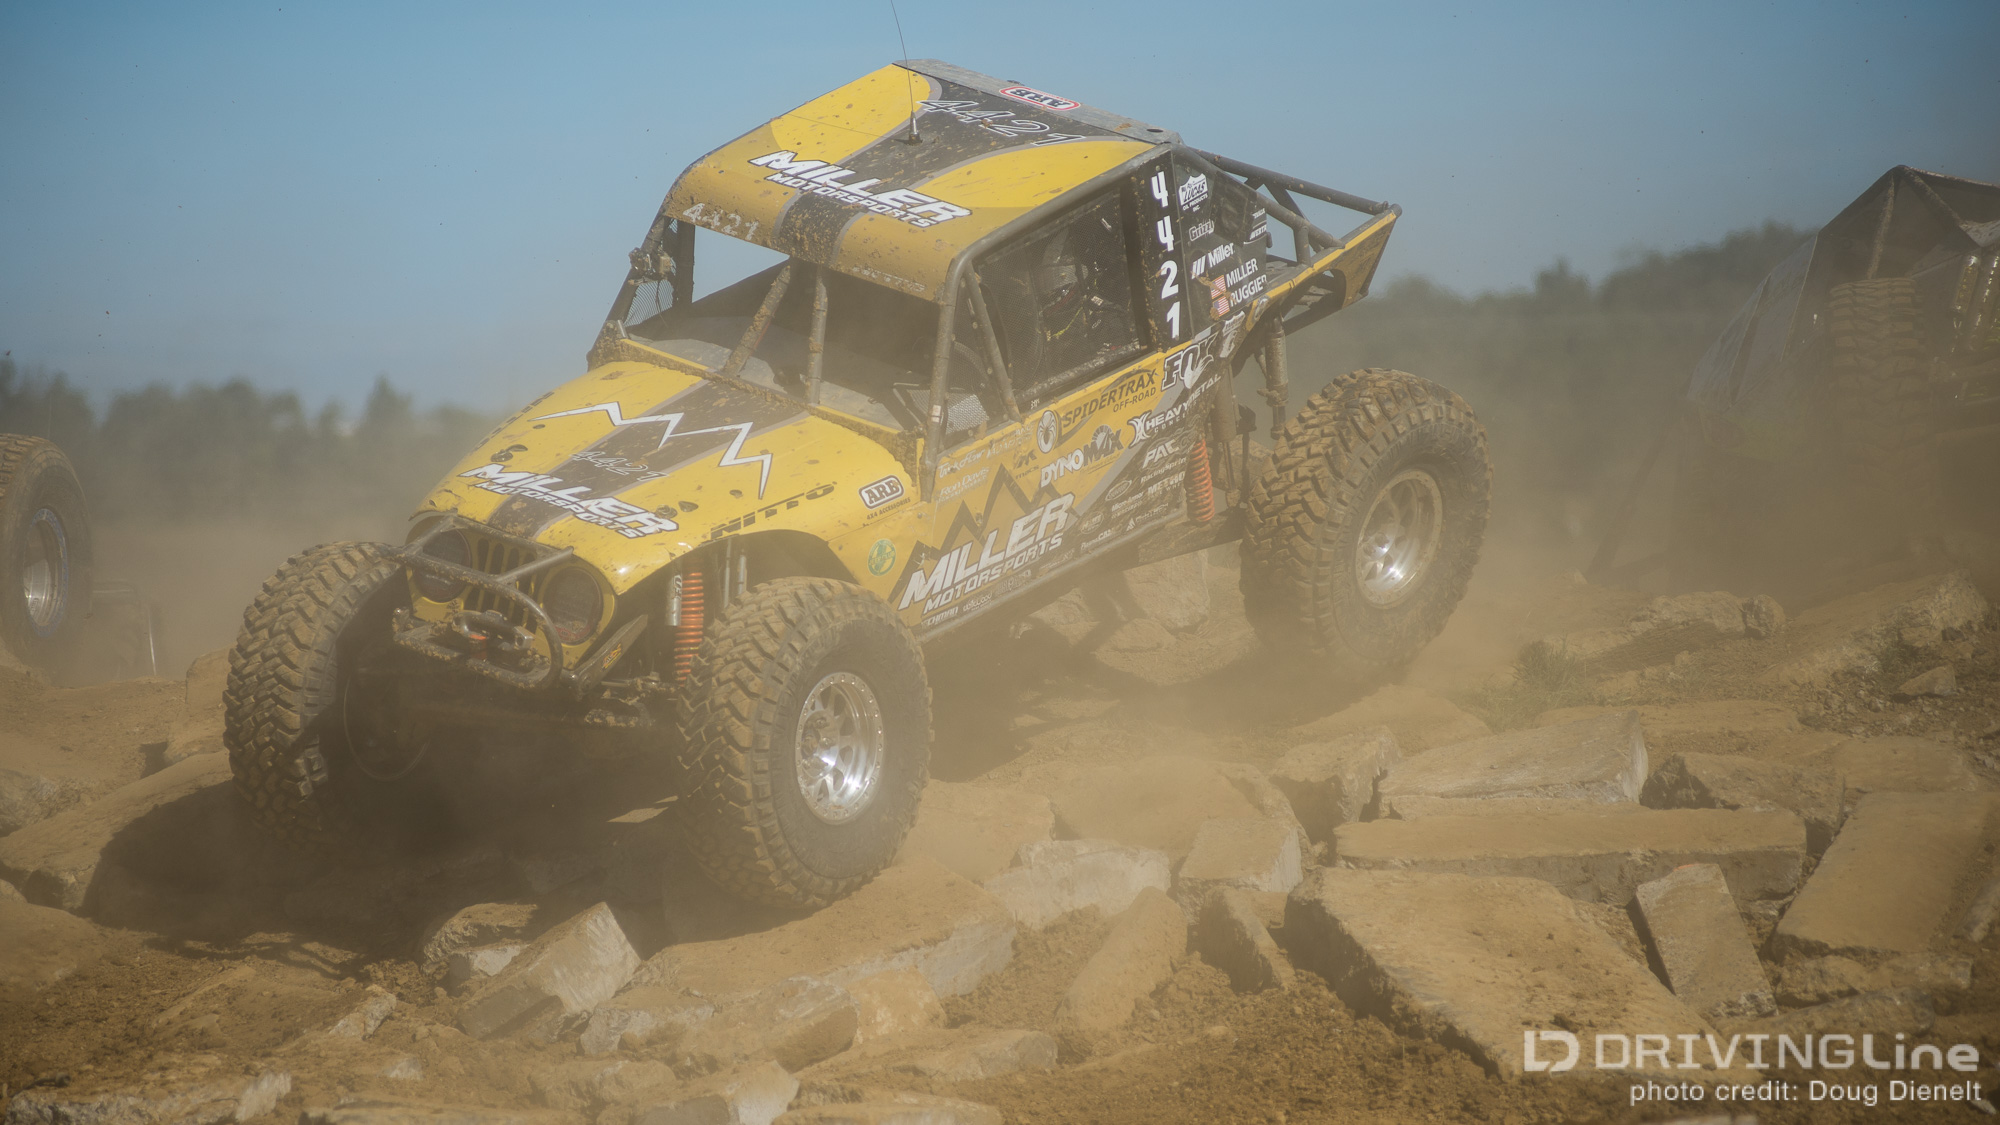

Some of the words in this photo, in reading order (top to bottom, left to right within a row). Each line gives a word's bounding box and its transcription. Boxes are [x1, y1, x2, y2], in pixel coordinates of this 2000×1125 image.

[916, 100, 1086, 147] 4421
[747, 150, 972, 226] MILLER
[764, 173, 937, 229] MOTORSPORTS
[1183, 181, 1206, 203] LUCAS
[1207, 243, 1235, 269] Miller
[1226, 258, 1259, 288] MILLER
[1062, 368, 1158, 428] SPIDERTRAX
[1112, 387, 1157, 413] OFF-ROAD
[567, 451, 669, 483] 4421
[1142, 437, 1180, 469] PAC
[456, 462, 679, 536] MILLER
[474, 480, 645, 540] MOTORSPORTS
[710, 483, 835, 540] NITTO
[865, 479, 900, 505] ARB
[866, 511, 879, 521] 4X4
[879, 497, 911, 516] ACCESSORIES
[896, 492, 1075, 612] MILLER
[922, 531, 1064, 616] MOTORSPORTS
